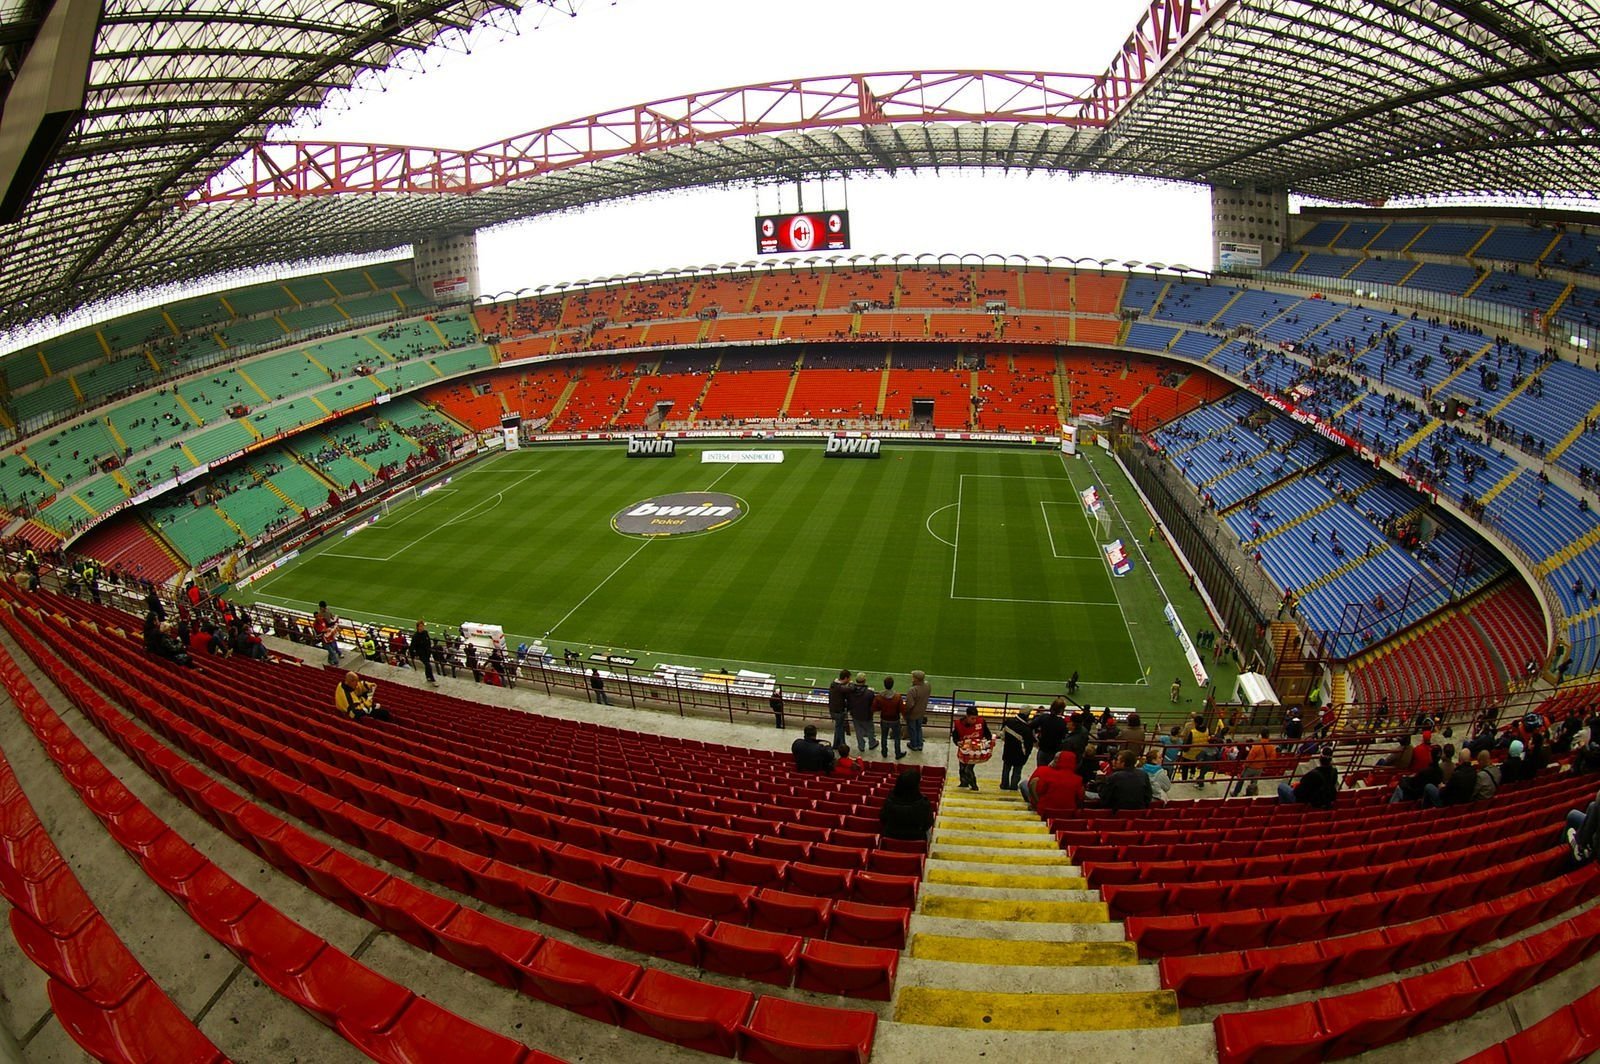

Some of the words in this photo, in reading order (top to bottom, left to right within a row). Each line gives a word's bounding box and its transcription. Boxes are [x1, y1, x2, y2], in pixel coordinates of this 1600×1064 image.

[628, 435, 673, 453] bwin
[827, 433, 881, 453] bwin
[626, 503, 734, 517] bwin
[650, 518, 686, 526] Poker
[253, 565, 274, 580] RICOH
